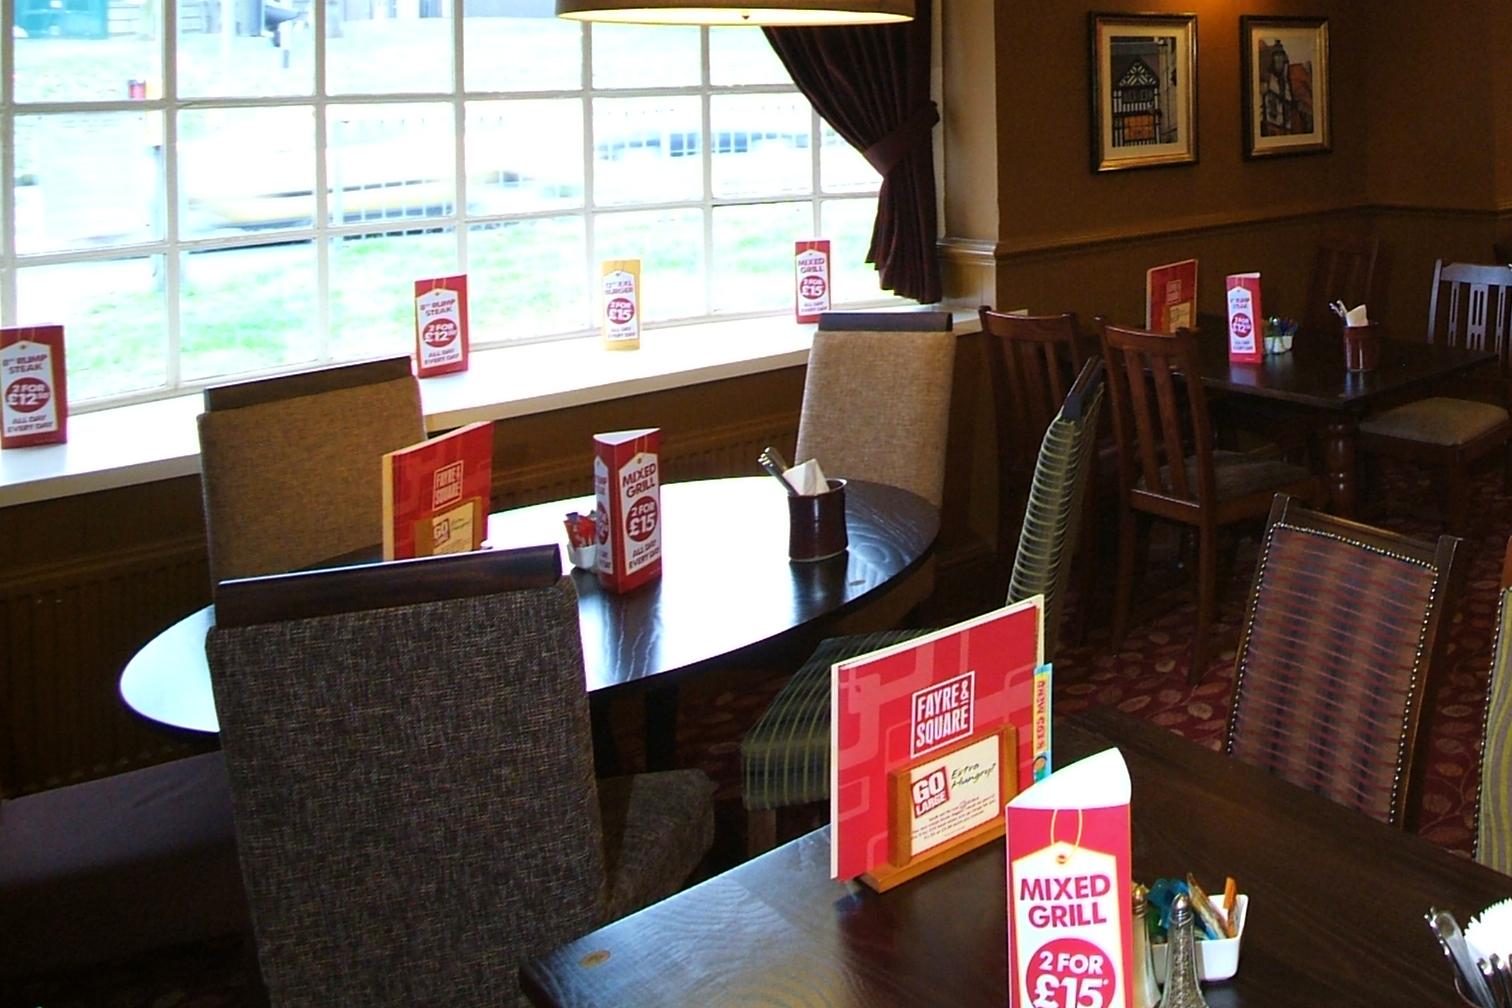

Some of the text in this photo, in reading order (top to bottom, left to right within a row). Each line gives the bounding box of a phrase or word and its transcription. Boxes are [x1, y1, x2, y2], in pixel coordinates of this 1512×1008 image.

[798, 257, 825, 267] MIXED
[800, 265, 824, 274] GRILL
[801, 285, 825, 296] £15
[425, 306, 453, 317] STEAK
[609, 308, 633, 321] £15
[436, 323, 454, 331] FOR
[16, 353, 48, 365] RUMP
[8, 363, 43, 375] STEAK
[20, 383, 45, 392] FOR
[622, 463, 657, 486] MIXED
[626, 477, 656, 498] GRILL
[631, 501, 656, 517] 2 FOR
[433, 521, 449, 539] GO
[628, 511, 656, 538] £15
[633, 540, 657, 558] ALL DAY
[629, 548, 661, 570] EVERY DAY
[917, 679, 970, 722] FAYRE &
[916, 705, 969, 748] SQUARE
[951, 763, 980, 780] Extra
[913, 771, 945, 805] GO
[915, 790, 947, 817] LARGE
[1020, 874, 1111, 901] MIXED
[1028, 902, 1107, 929] GRILL
[1039, 950, 1104, 975] 2 FOR
